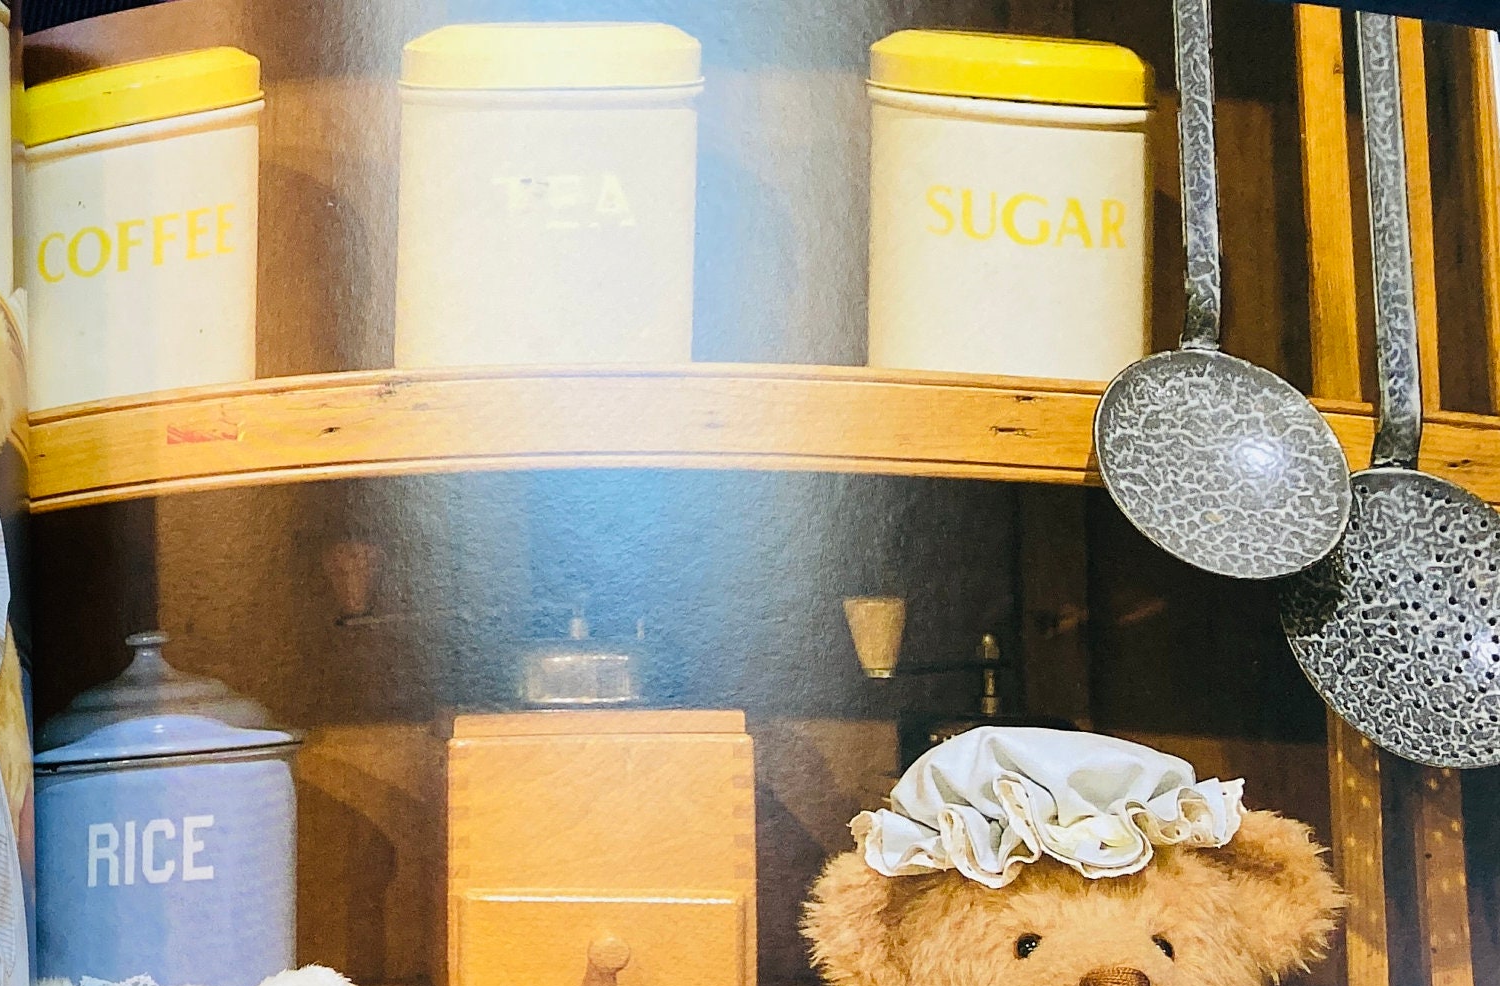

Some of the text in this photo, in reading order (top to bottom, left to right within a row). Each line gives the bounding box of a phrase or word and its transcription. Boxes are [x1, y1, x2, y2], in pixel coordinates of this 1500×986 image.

[38, 204, 236, 284] COFFEE
[925, 185, 1127, 249] SUGAR
[87, 815, 214, 887] RICE
